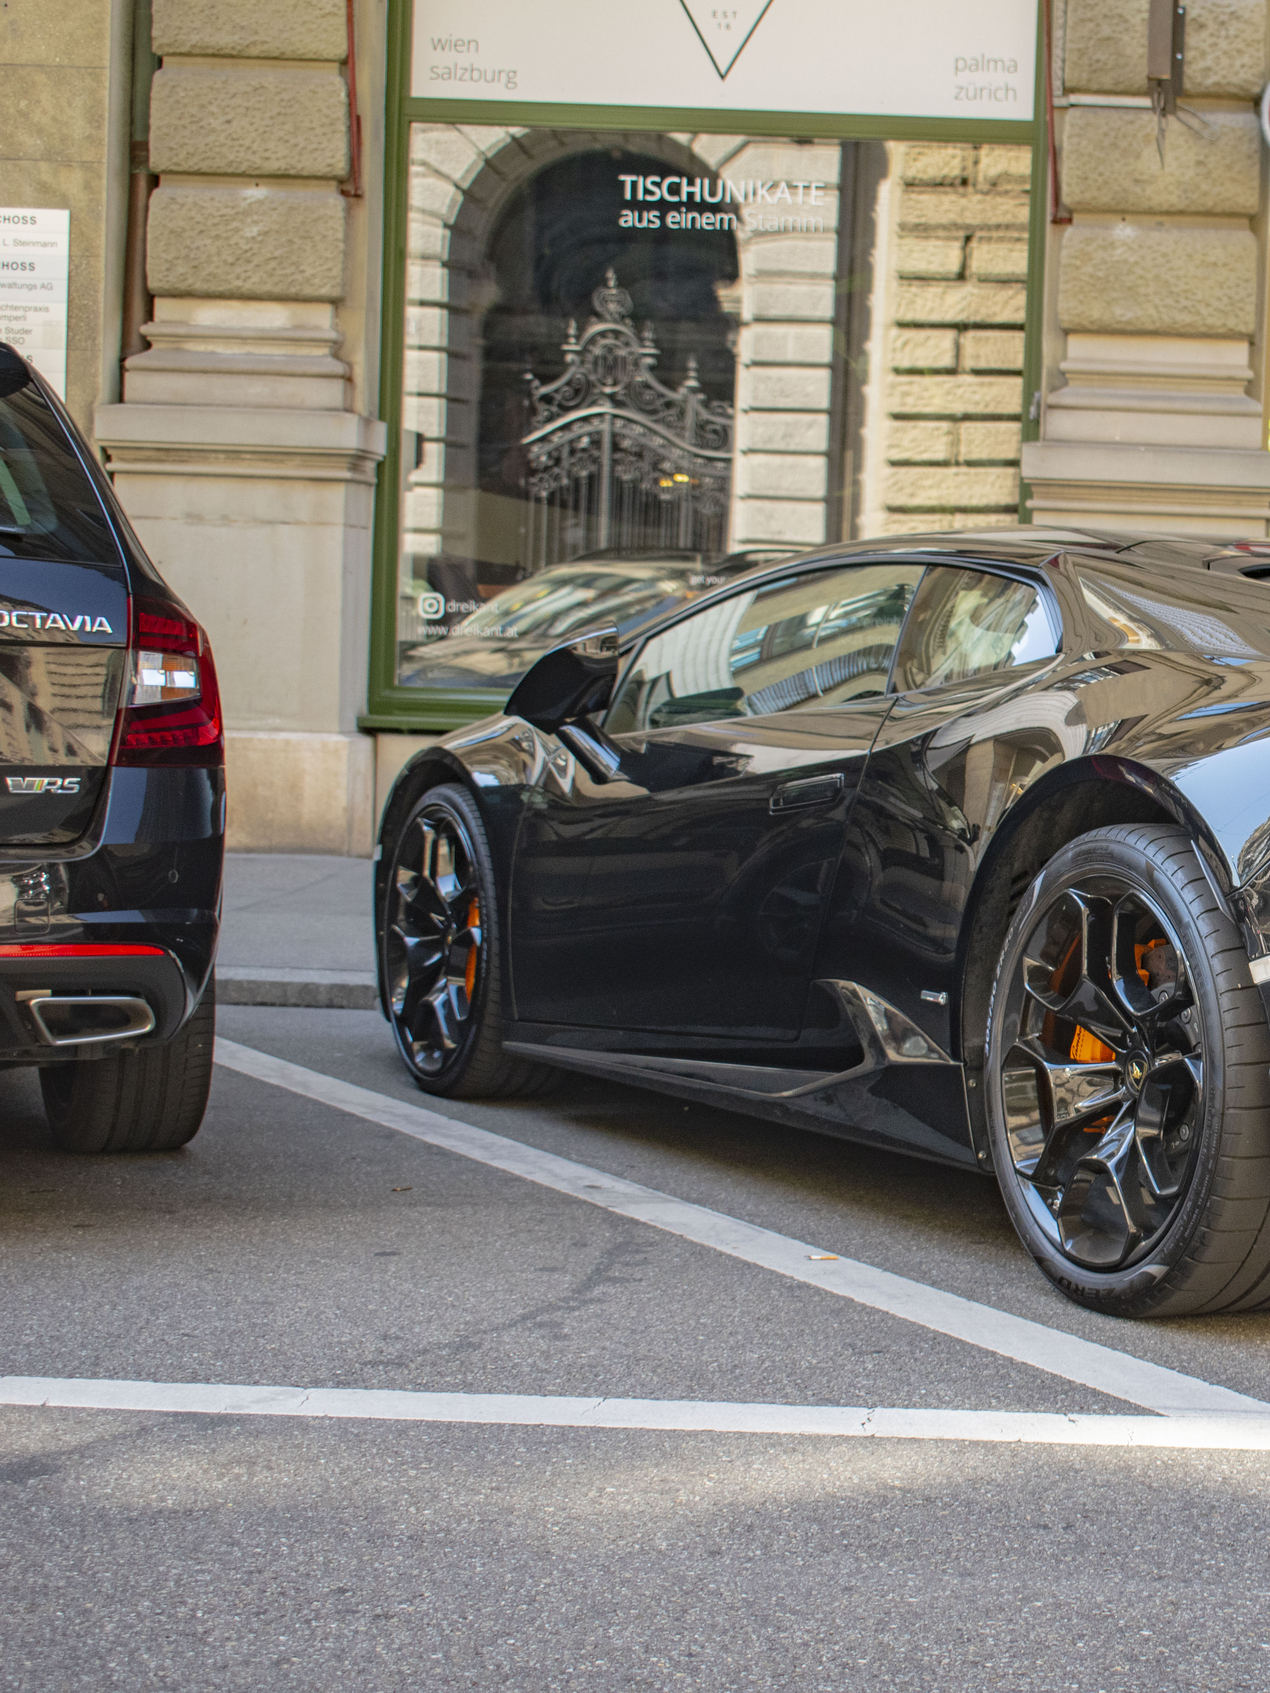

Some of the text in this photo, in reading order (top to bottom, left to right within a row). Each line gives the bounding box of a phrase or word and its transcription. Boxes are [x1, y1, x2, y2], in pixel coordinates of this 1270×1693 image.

[712, 10, 737, 20] EST
[430, 34, 480, 54] wien
[954, 53, 1018, 77] palma
[428, 61, 519, 91] salzburg
[953, 81, 1017, 103] zürich
[618, 174, 826, 207] TISCHUNIKATE
[618, 207, 824, 234] aus einem Stamm
[13, 239, 58, 249] Steinmann
[40, 283, 54, 291] AG
[5, 326, 33, 335] Studer
[5, 336, 26, 345] SSO
[446, 599, 499, 613] dreikant
[0, 610, 113, 634] OCTAVIA
[418, 625, 519, 638] www.dreikant.at
